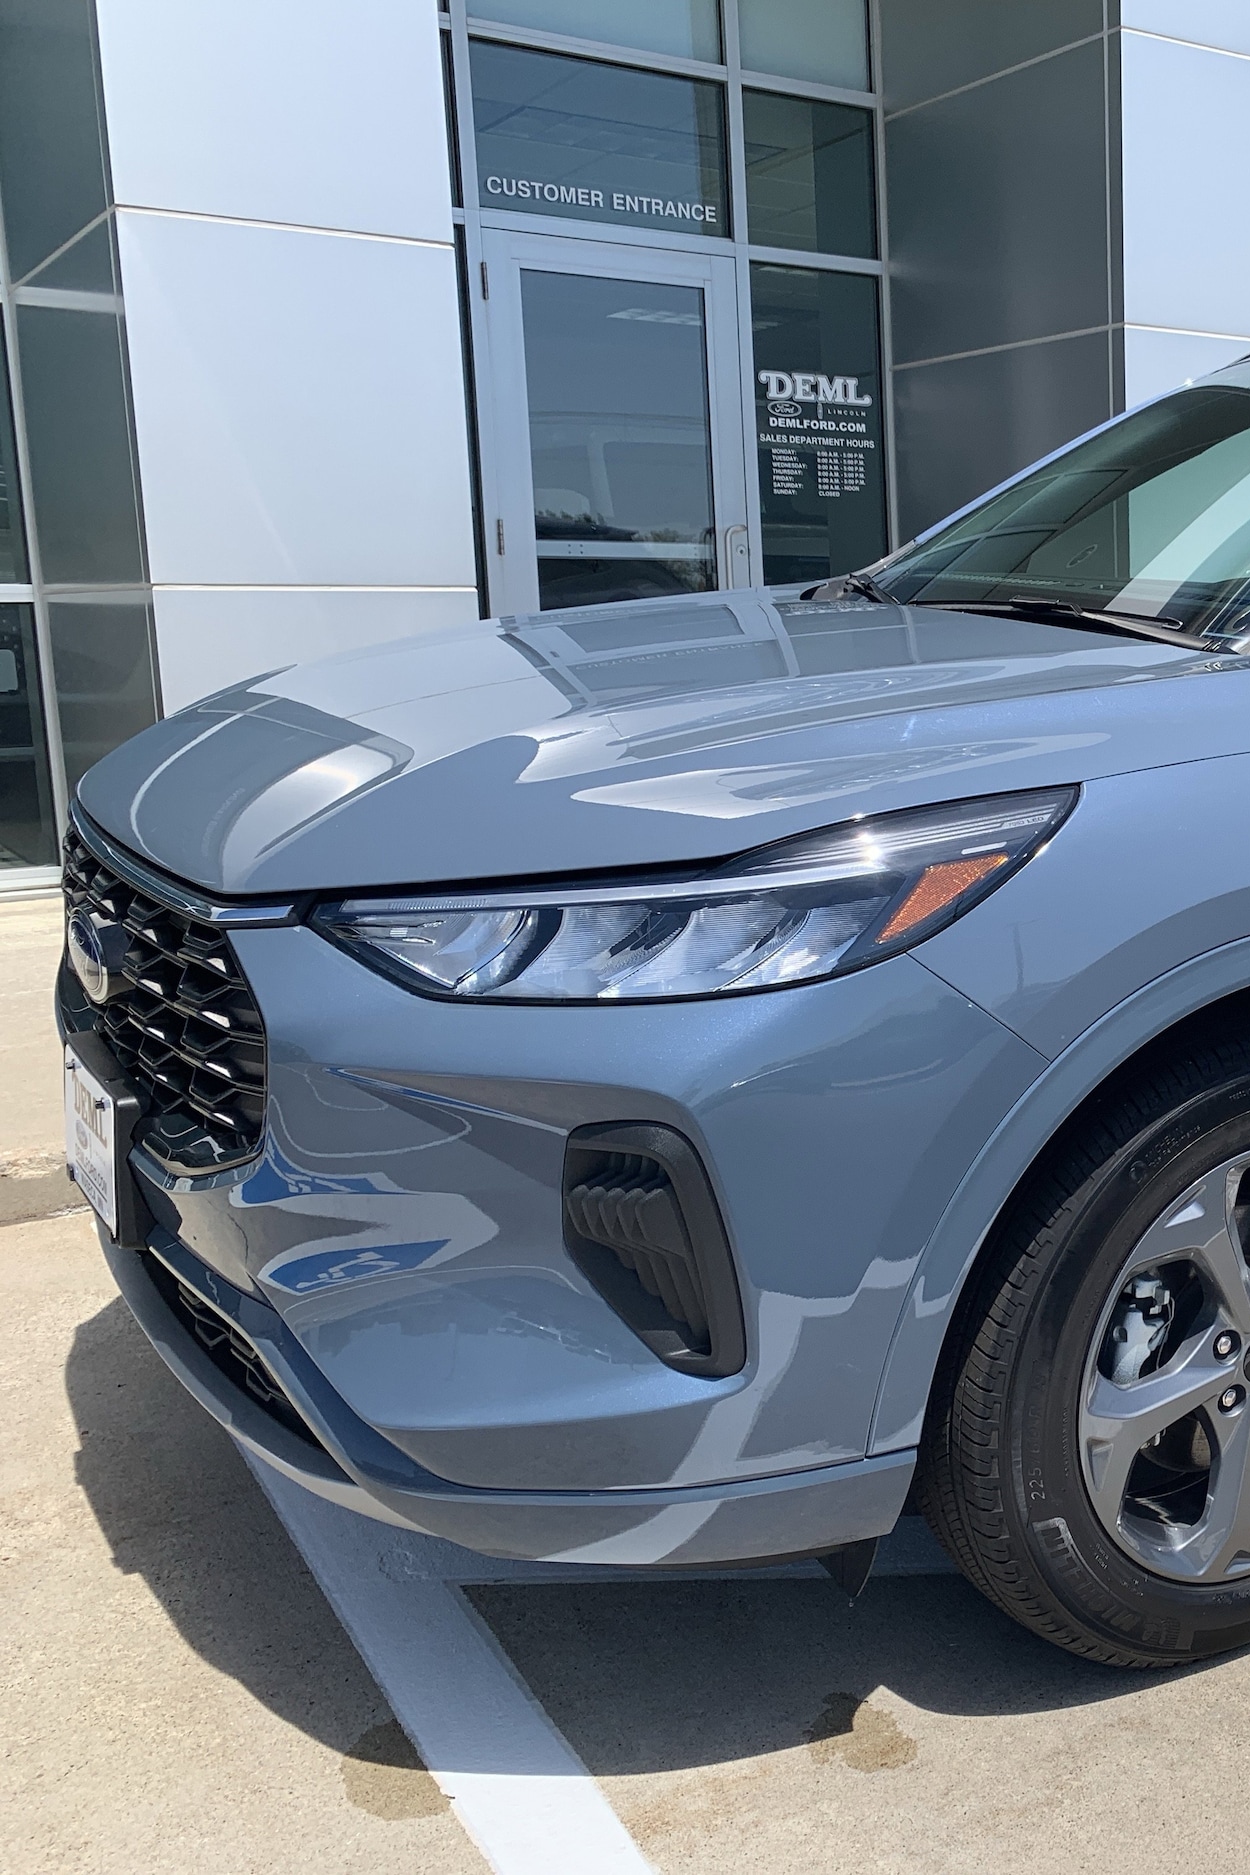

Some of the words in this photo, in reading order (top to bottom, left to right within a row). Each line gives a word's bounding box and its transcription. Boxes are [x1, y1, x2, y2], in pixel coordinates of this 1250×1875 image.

[487, 176, 604, 208] CUSTOMER
[613, 193, 717, 223] ENTRANCE
[758, 369, 872, 406] DEML
[827, 408, 866, 417] LINCOLN
[769, 416, 867, 433] DEMLFORD.COM
[759, 433, 788, 443] SALES
[790, 436, 844, 447] DEPARTMENT
[846, 439, 875, 449] HOURS
